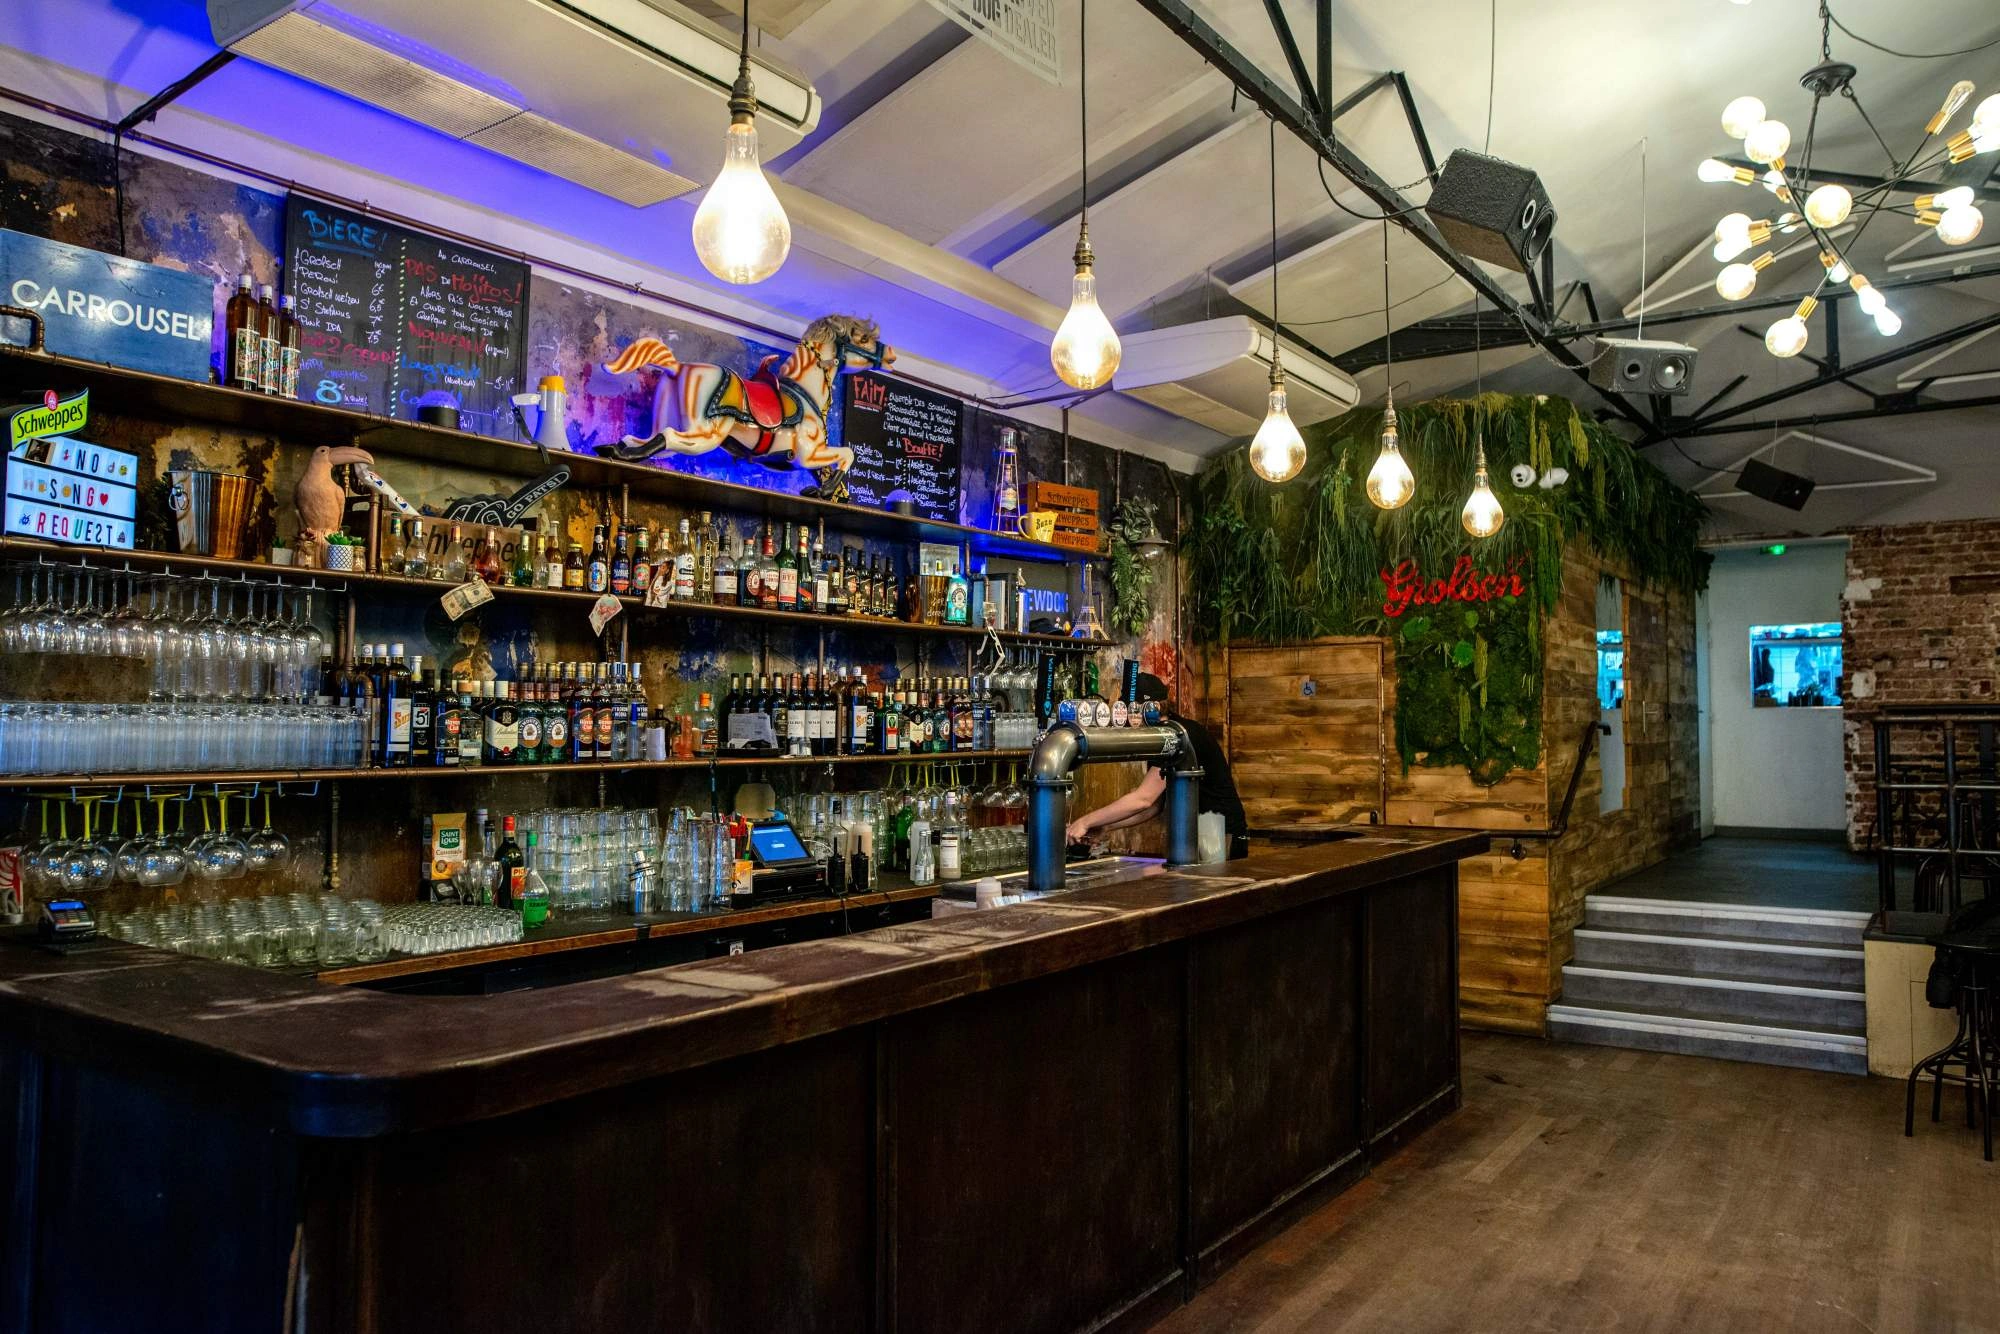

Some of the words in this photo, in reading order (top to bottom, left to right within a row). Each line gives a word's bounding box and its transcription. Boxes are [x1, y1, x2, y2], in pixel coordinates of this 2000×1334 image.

[405, 258, 437, 283] PAS
[11, 279, 202, 342] CARROUSEL
[17, 405, 84, 439] Schweppes
[76, 452, 99, 474] NO
[506, 503, 525, 520] GO
[525, 477, 562, 503] PATS!
[1047, 491, 1090, 507] Schweppes
[416, 709, 429, 725] 51
[441, 830, 459, 838] SAINT
[441, 836, 459, 846] LOUIS
